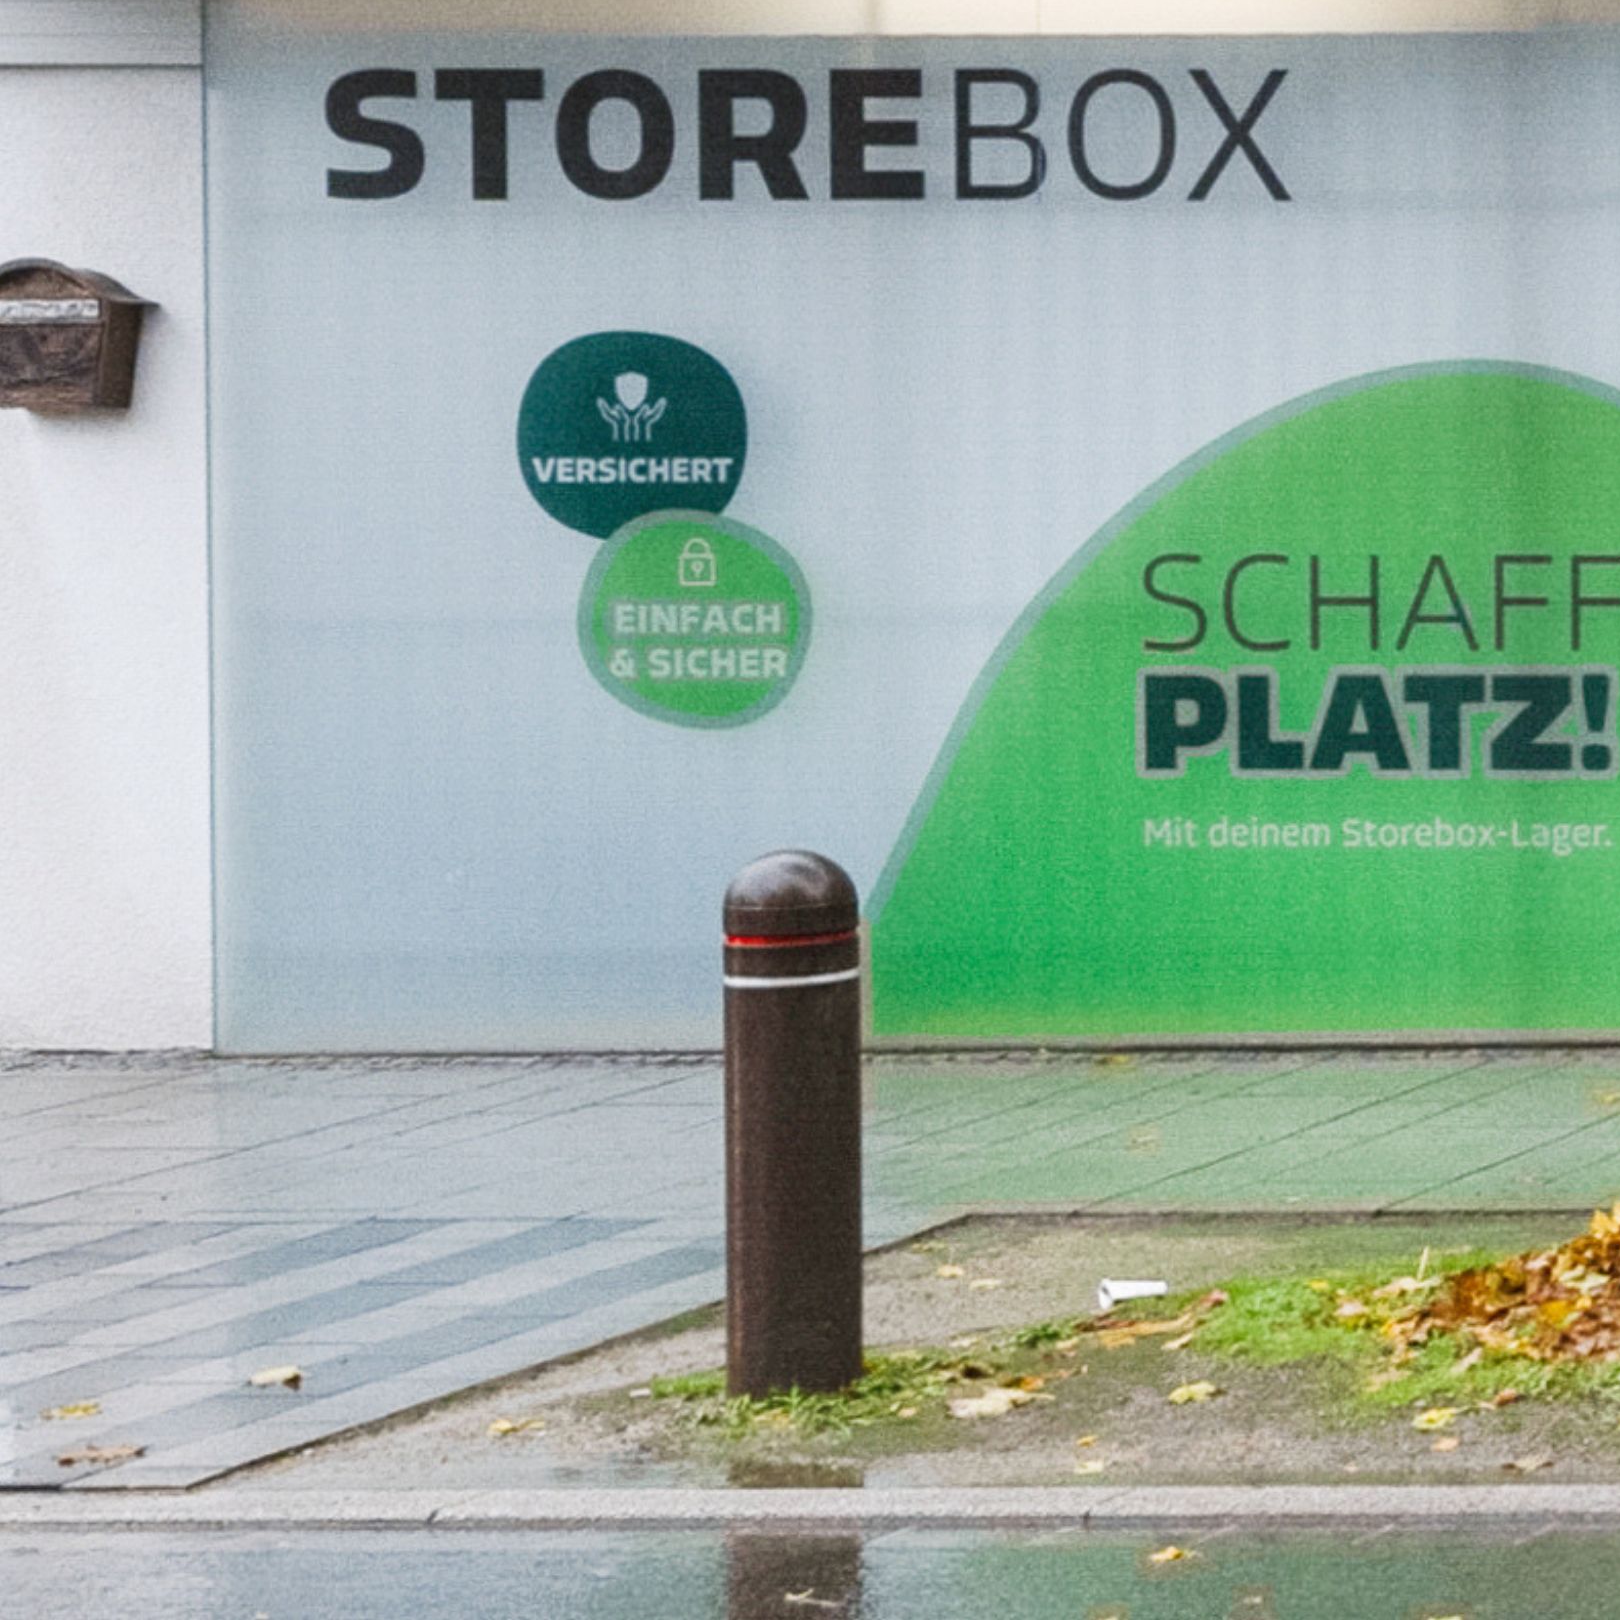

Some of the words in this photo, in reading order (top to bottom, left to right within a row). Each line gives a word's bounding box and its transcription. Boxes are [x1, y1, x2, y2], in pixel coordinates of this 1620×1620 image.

[324, 67, 1291, 202] STOREBOX
[533, 455, 733, 484] VERSICHERT
[614, 603, 782, 634] EINFACH
[609, 647, 640, 680] &
[647, 647, 788, 680] SICHER
[1144, 673, 1613, 772] PLATZ!
[1143, 817, 1199, 848] Mit
[1207, 816, 1331, 848] deinem
[1343, 815, 1613, 858] Storebox-Lager.
